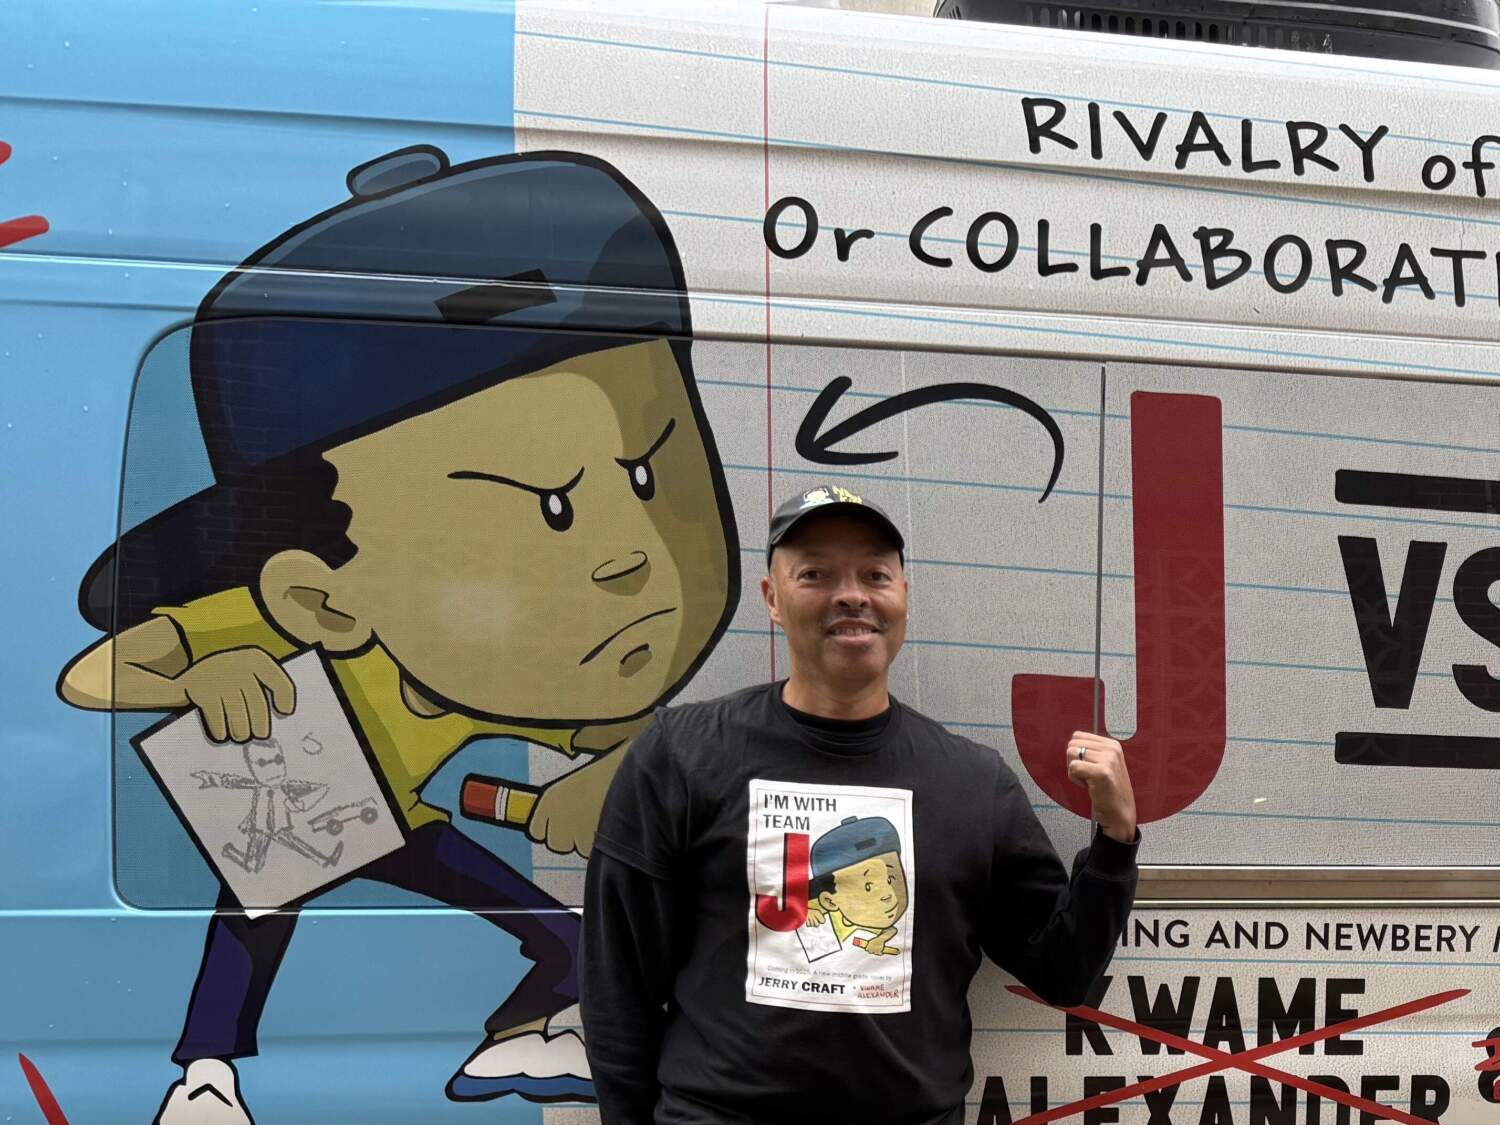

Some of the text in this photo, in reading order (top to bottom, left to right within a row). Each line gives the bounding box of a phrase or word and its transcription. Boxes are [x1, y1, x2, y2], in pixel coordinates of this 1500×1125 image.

[1021, 97, 1388, 182] RIVALRY
[763, 197, 874, 261] Or
[1011, 390, 1227, 824] J
[763, 815, 809, 830] TEAM
[764, 794, 836, 812] I'M WITH
[755, 832, 809, 932] J
[1204, 920, 1289, 950] AND
[1305, 922, 1480, 953] NEWBERY
[759, 977, 846, 994] JERRY CRAFT
[1065, 975, 1366, 1057] KWAME
